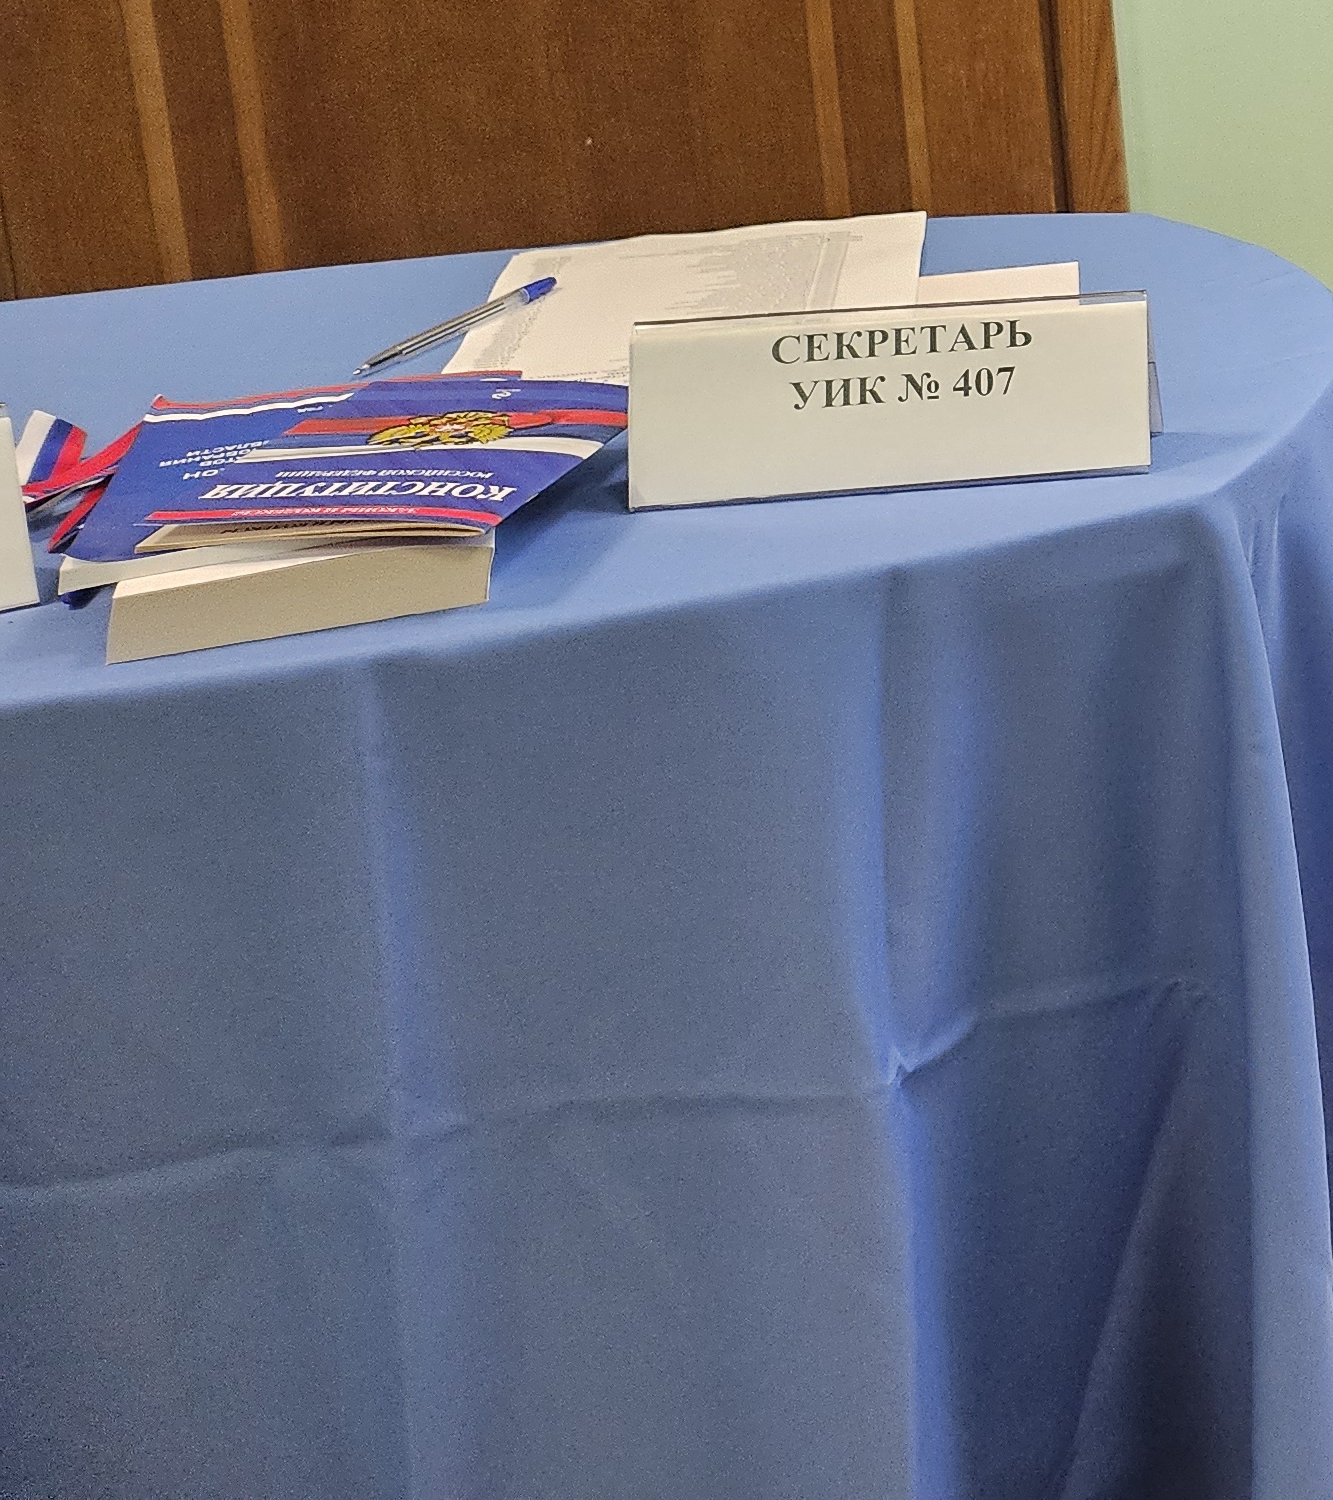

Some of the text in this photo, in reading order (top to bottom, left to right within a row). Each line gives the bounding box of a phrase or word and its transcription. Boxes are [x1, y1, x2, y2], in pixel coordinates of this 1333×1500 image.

[771, 319, 1033, 365] СЕКРЕТАРЬ
[789, 366, 1016, 410] УИК № 407
[158, 448, 254, 467] ОБРАНИЯ
[185, 440, 269, 457] БЛАСТИ
[182, 468, 226, 480] ОН
[198, 480, 518, 502] КОНСТИТУЦИЯ
